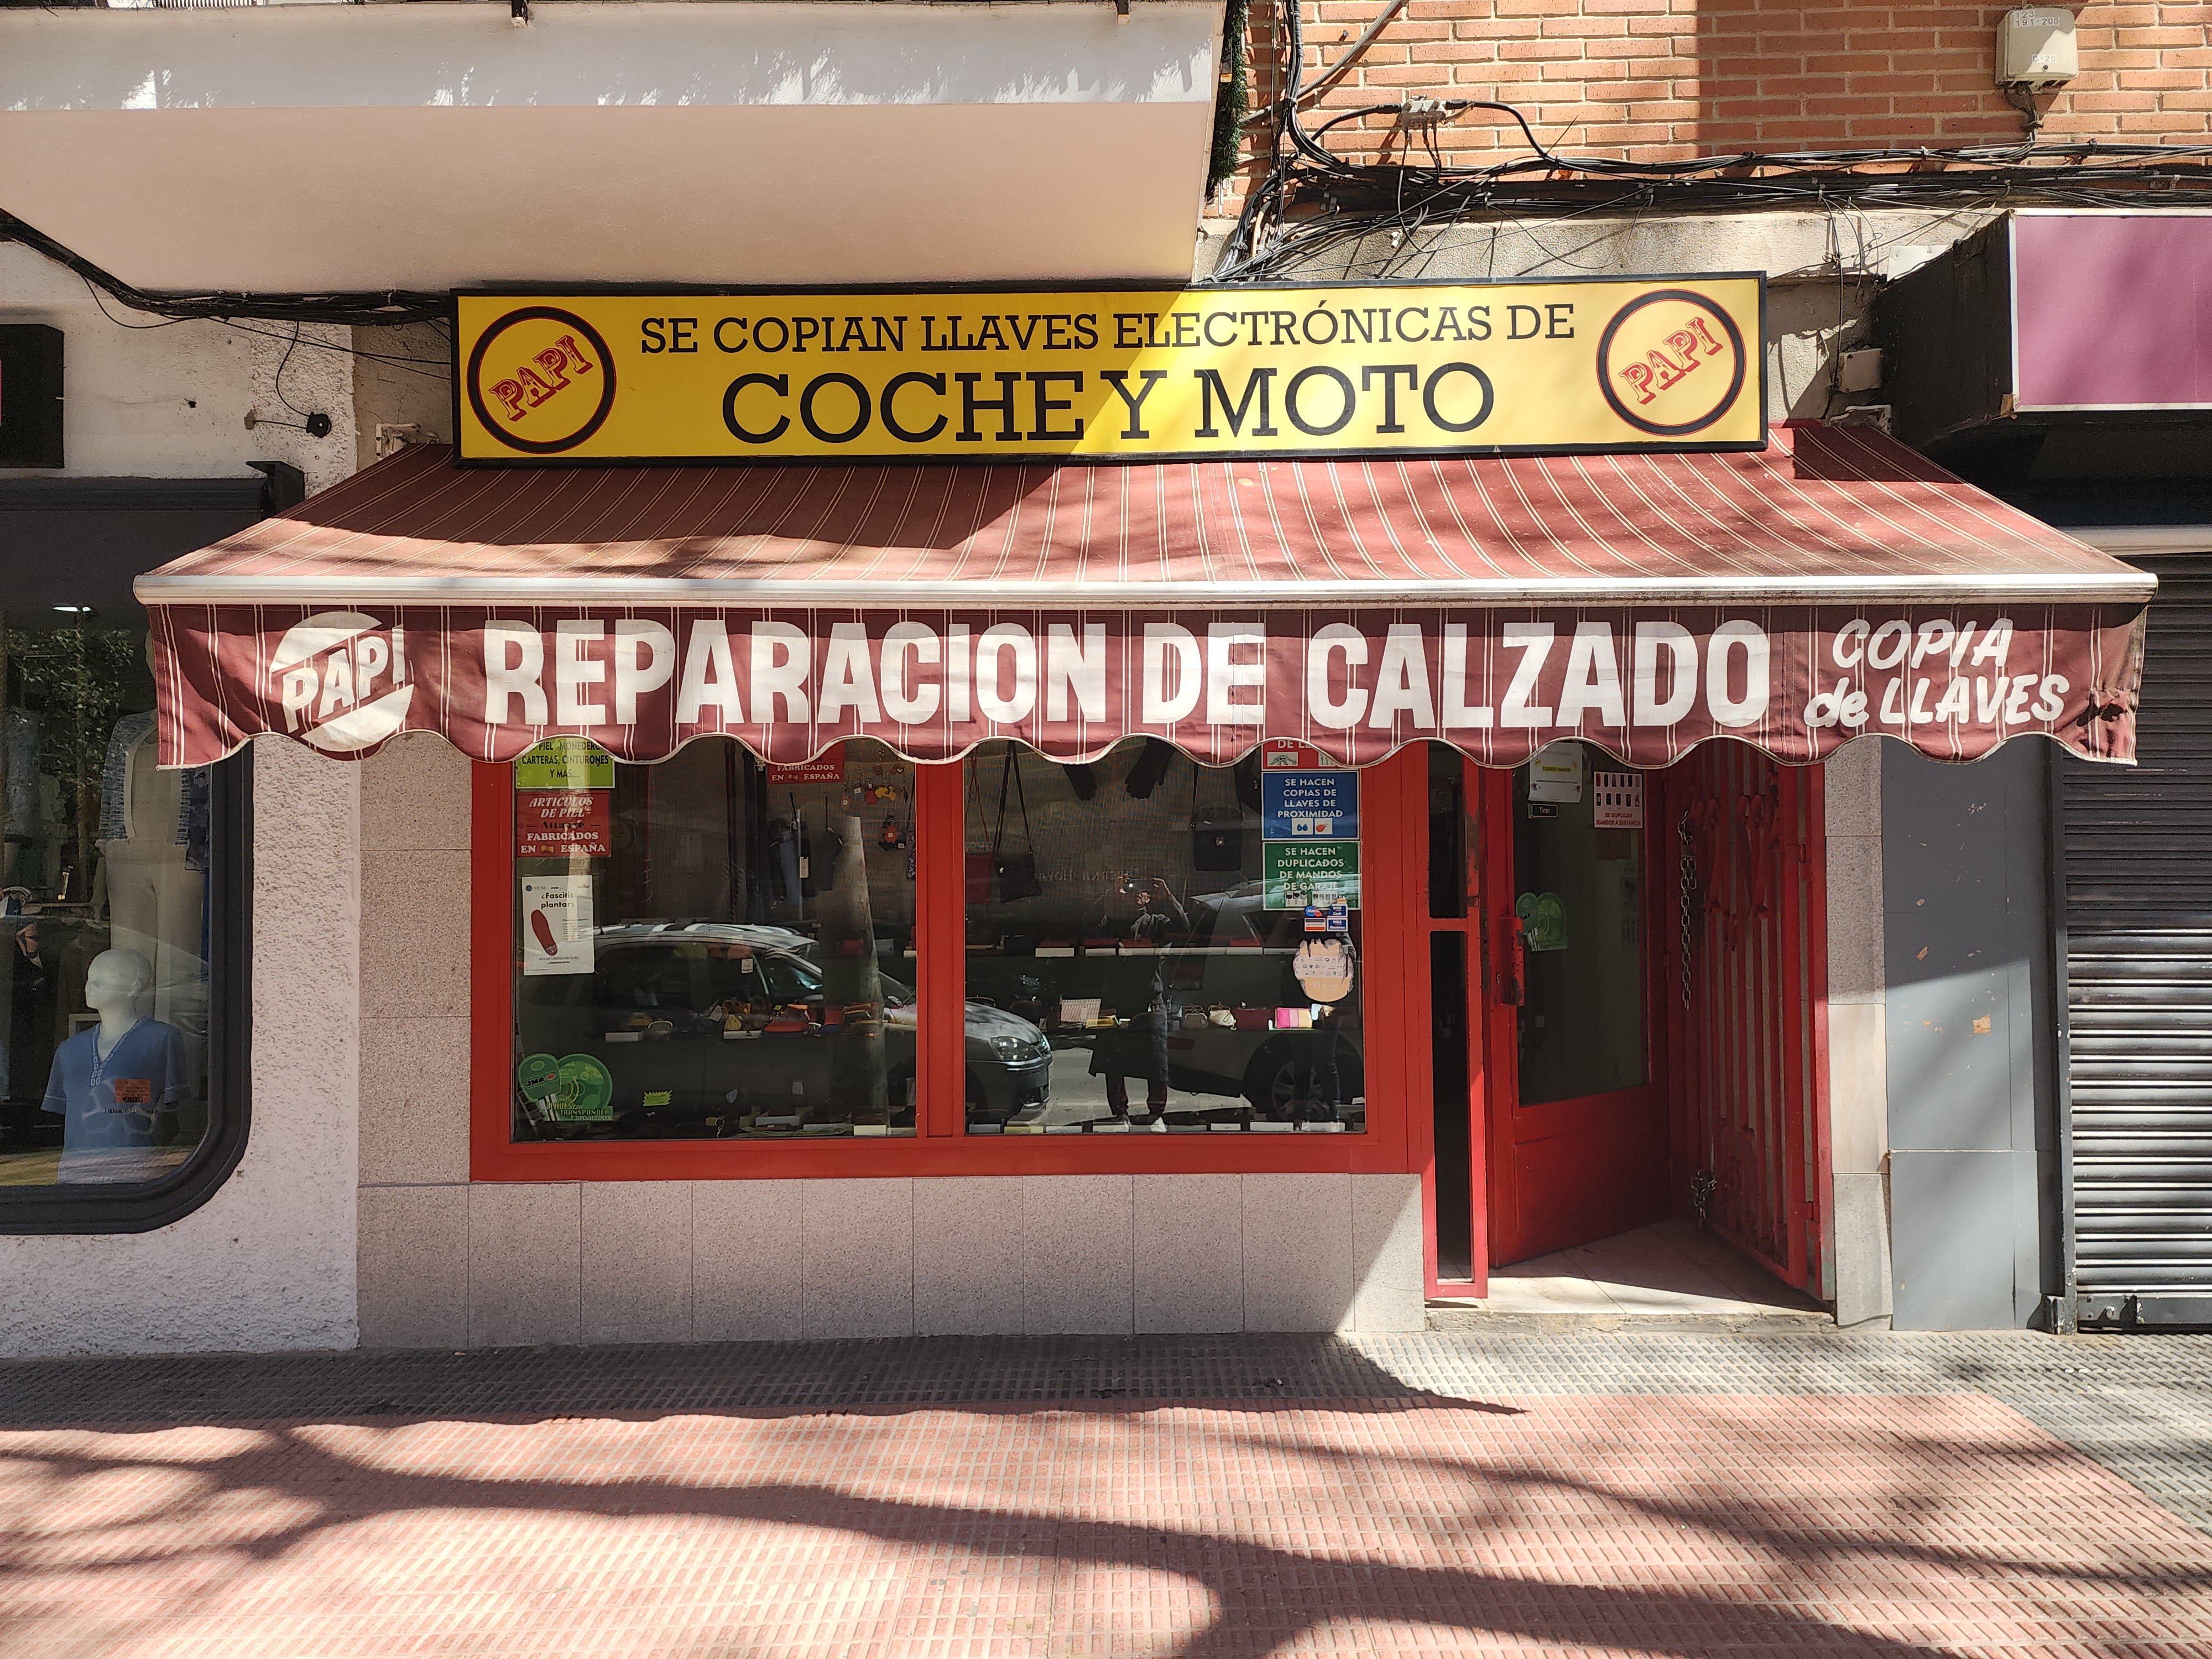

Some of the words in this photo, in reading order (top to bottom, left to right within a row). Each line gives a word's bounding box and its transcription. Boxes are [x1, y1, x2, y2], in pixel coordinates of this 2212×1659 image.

[2016, 18, 2058, 26] 191-200
[641, 316, 698, 354] SE
[713, 315, 906, 353] COPIAN
[920, 314, 1098, 351] LLAVES
[1113, 299, 1492, 349] ELECTRÓNICAS
[1507, 303, 1575, 340] DE
[1618, 316, 1723, 405] PAPI
[488, 334, 594, 421] PAPI
[722, 371, 1084, 444] COCHE
[1100, 369, 1167, 439] Y
[1194, 362, 1494, 437] MOTO
[1832, 618, 2013, 670] COPIA
[281, 624, 407, 734] PAPI
[484, 619, 1106, 726] REPARACION
[1143, 622, 1265, 724] DE
[1307, 619, 1771, 729] CALZADO
[1803, 677, 1869, 728] de
[1880, 674, 2070, 725] LLAVES
[1277, 740, 1294, 749] DE
[522, 755, 560, 766] CARTERAS,
[562, 755, 609, 765] CINTURONES
[549, 769, 555, 778] Y
[804, 771, 840, 780] ESPAÑA
[540, 808, 556, 818] DE
[526, 832, 599, 841] FABRICADOS
[520, 845, 536, 853] EN
[560, 842, 606, 852] ESPAÑA
[1285, 847, 1297, 855] SE
[1300, 847, 1335, 855] HACEN
[1277, 859, 1344, 867] DUPLICADOS
[1280, 870, 1293, 879] DE
[1296, 870, 1342, 879] MANDOS
[1284, 882, 1297, 890] DE
[1300, 882, 1338, 890] GARAJE
[541, 891, 573, 900] ¿Fascitis
[541, 901, 574, 910] plantar?
[526, 1077, 545, 1087] JMA
